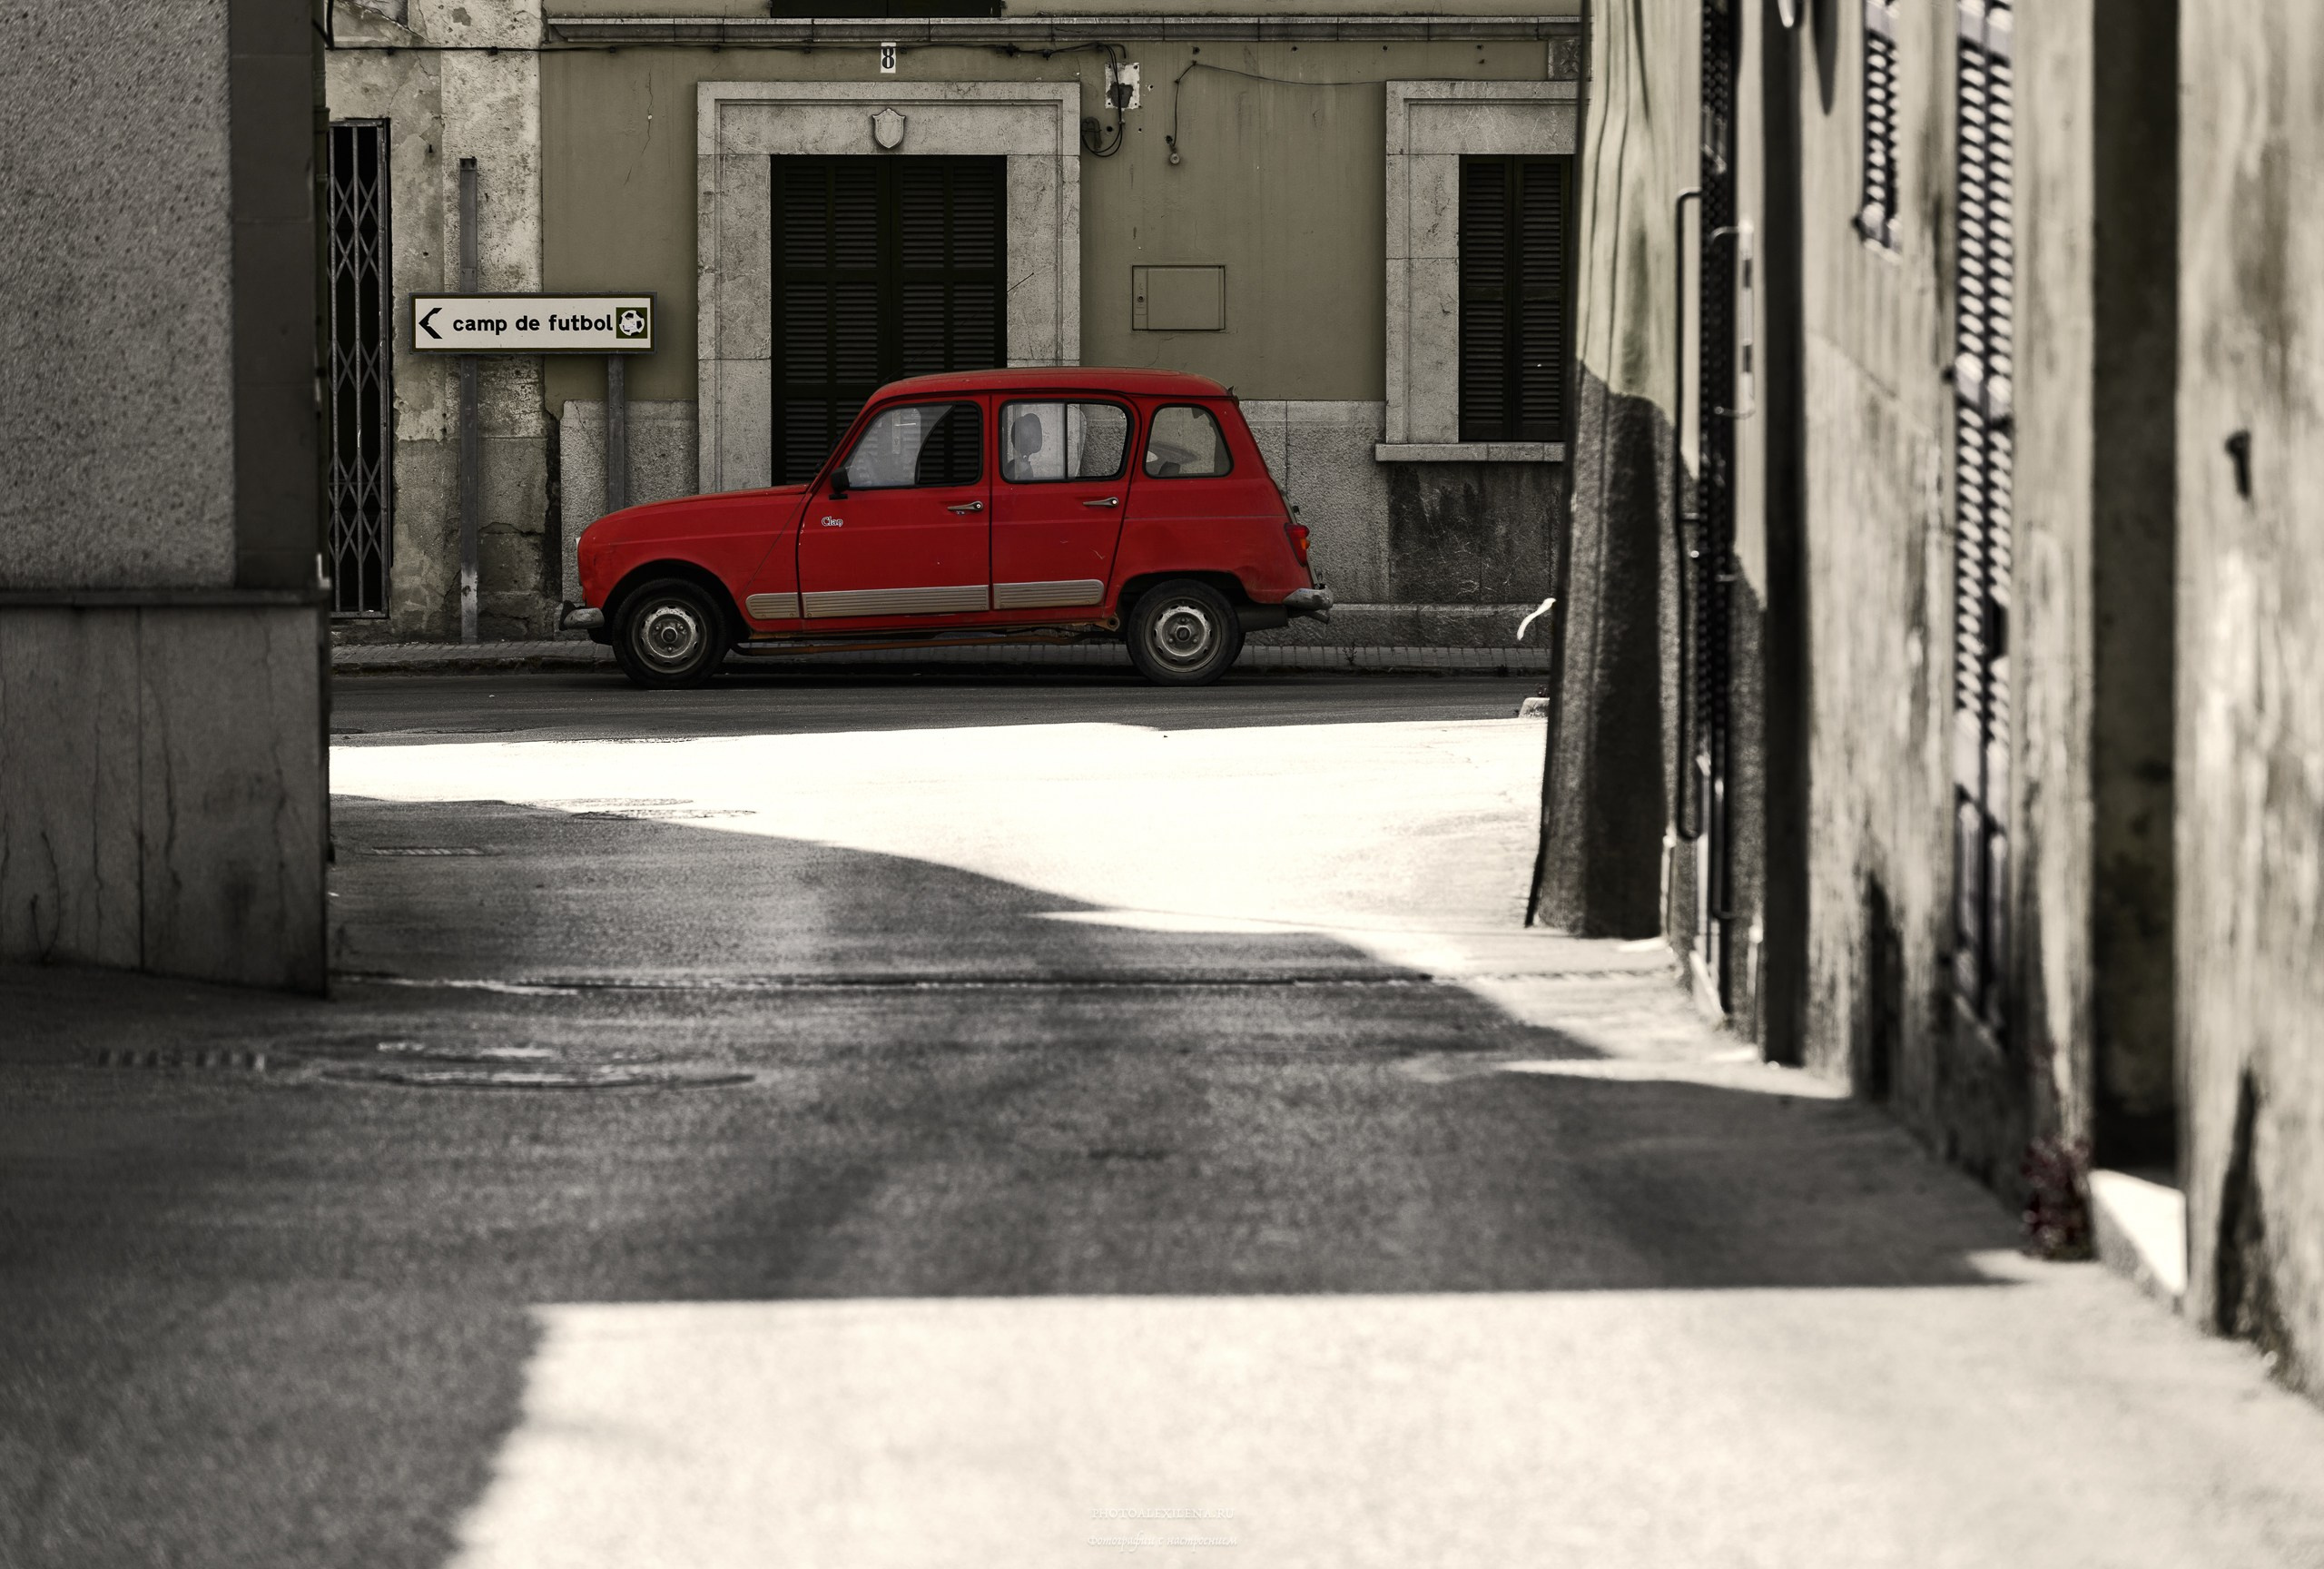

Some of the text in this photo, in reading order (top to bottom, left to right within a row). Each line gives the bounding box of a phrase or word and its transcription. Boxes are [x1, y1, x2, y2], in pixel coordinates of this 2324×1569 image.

[881, 46, 895, 69] 8
[453, 314, 613, 335] camp de futbol
